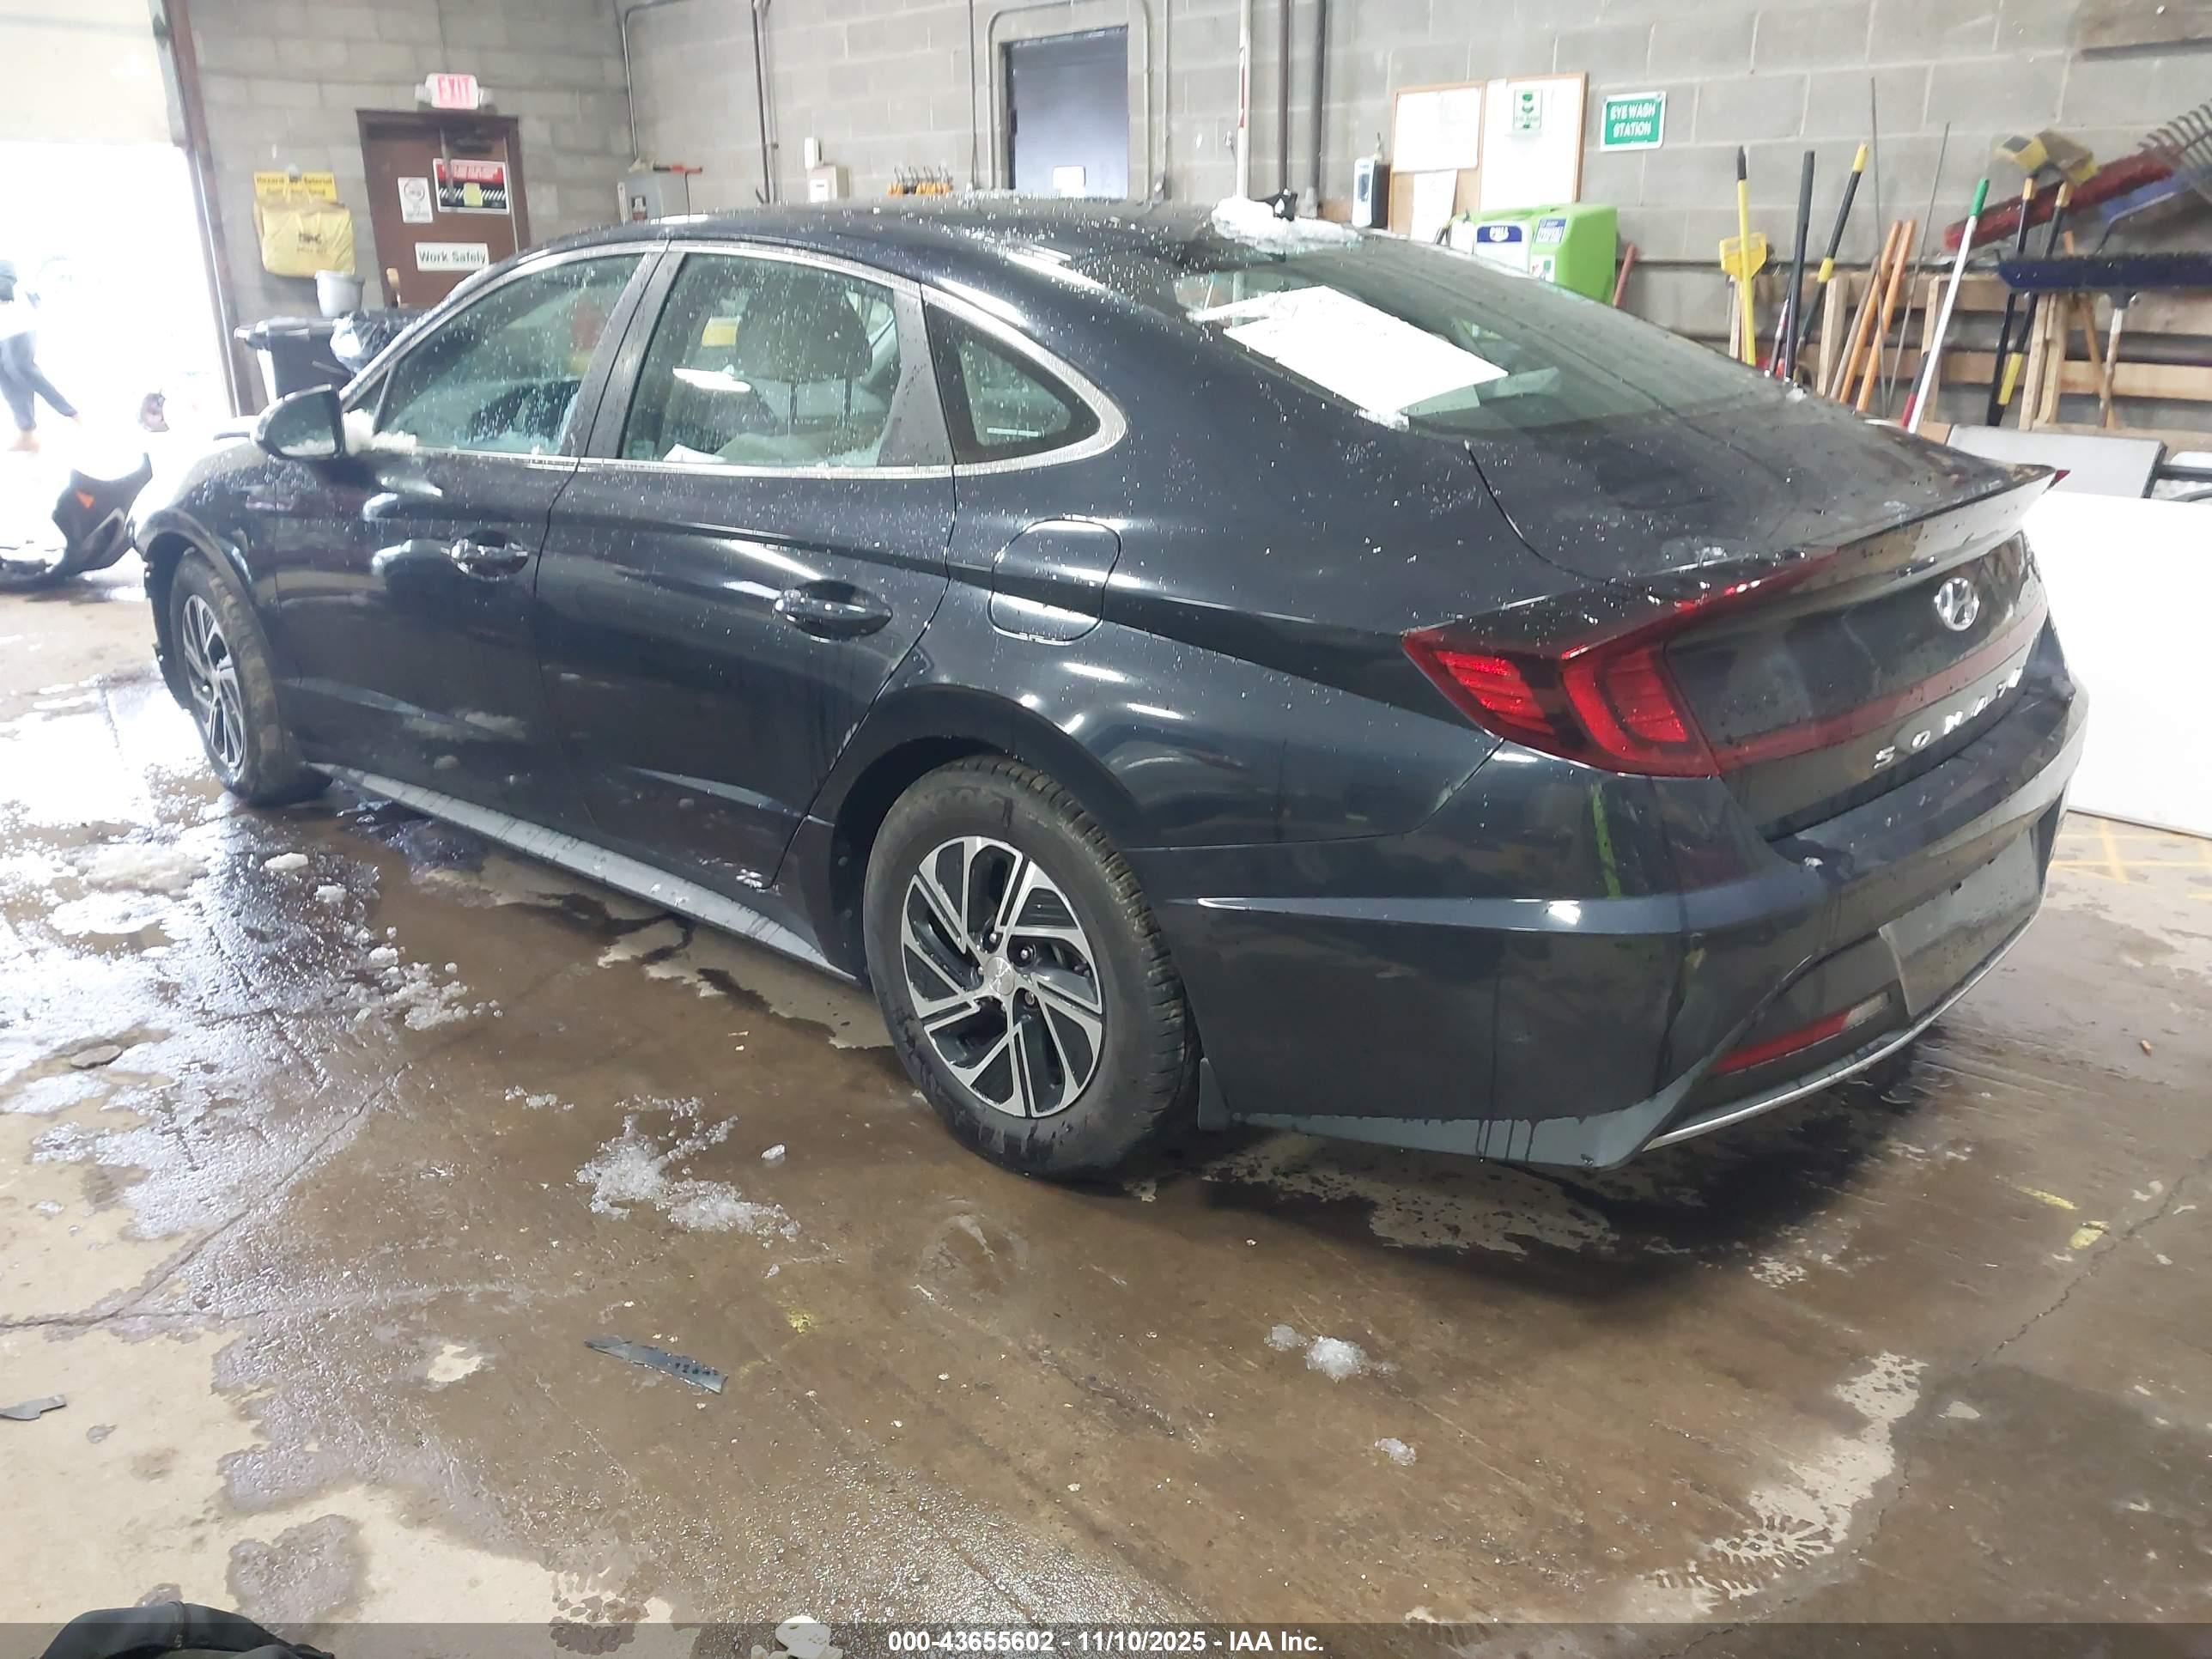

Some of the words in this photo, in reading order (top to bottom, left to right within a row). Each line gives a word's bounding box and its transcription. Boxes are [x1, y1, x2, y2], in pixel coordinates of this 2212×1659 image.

[437, 75, 471, 107] EXIT
[1610, 105, 1628, 120] EYE
[1629, 102, 1656, 118] WASH
[1613, 121, 1651, 137] STATION
[419, 250, 447, 263] Work
[452, 250, 486, 264] Safely
